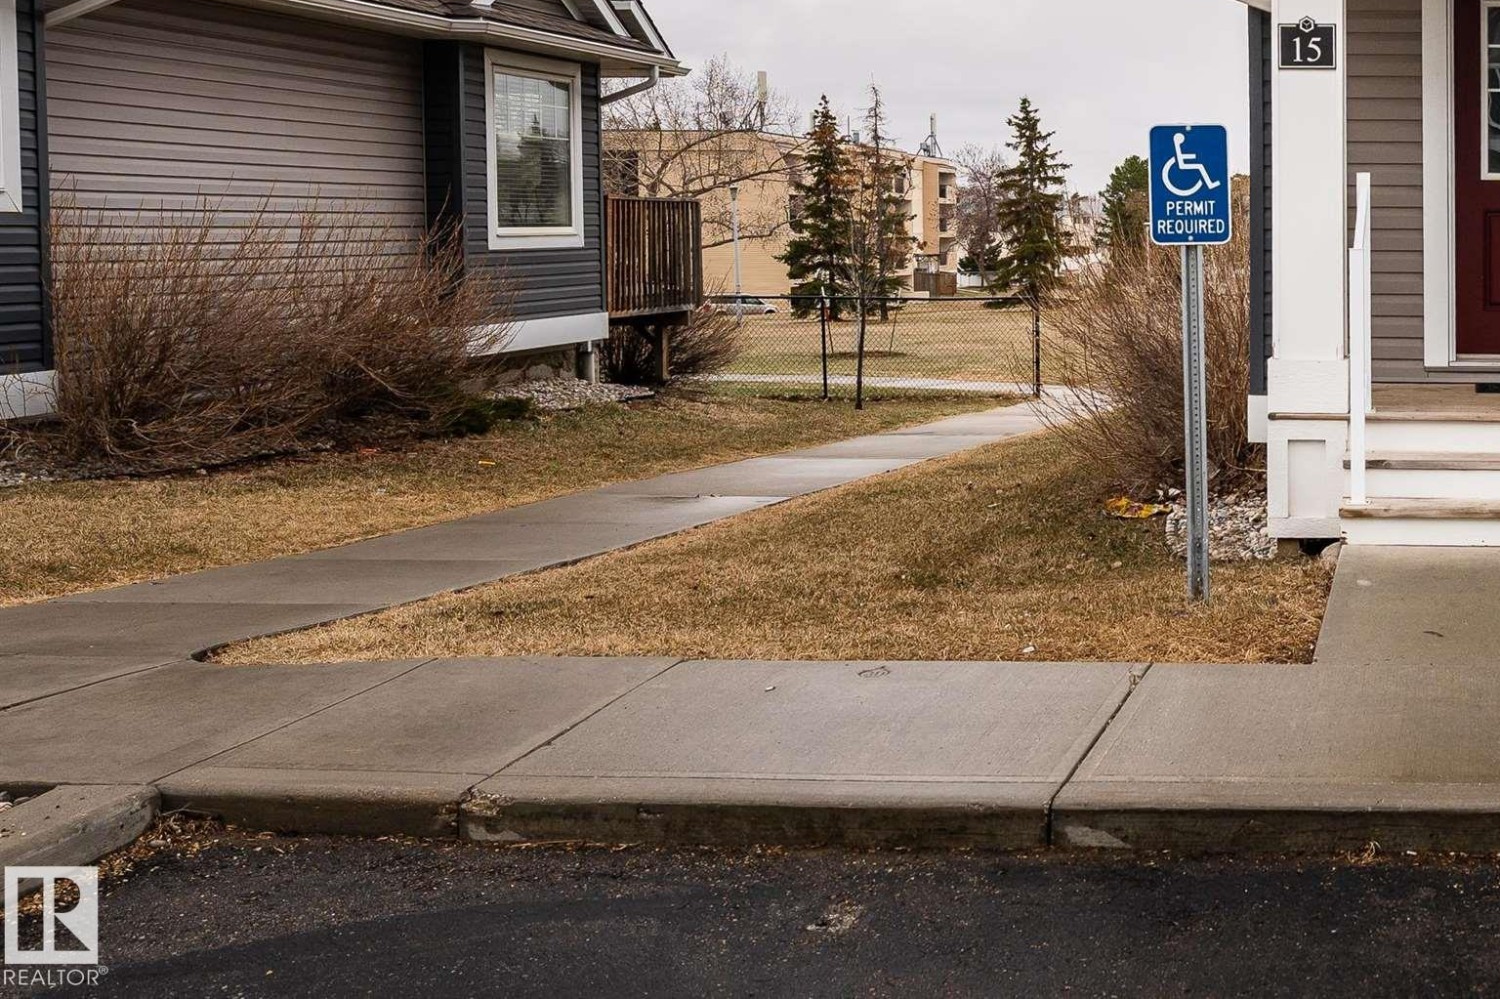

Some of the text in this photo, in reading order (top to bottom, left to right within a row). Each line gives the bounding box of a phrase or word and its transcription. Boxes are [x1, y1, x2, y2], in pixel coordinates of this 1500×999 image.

[1292, 36, 1322, 63] 15
[1166, 200, 1216, 216] PERMIT
[1157, 218, 1225, 234] REQUIRED
